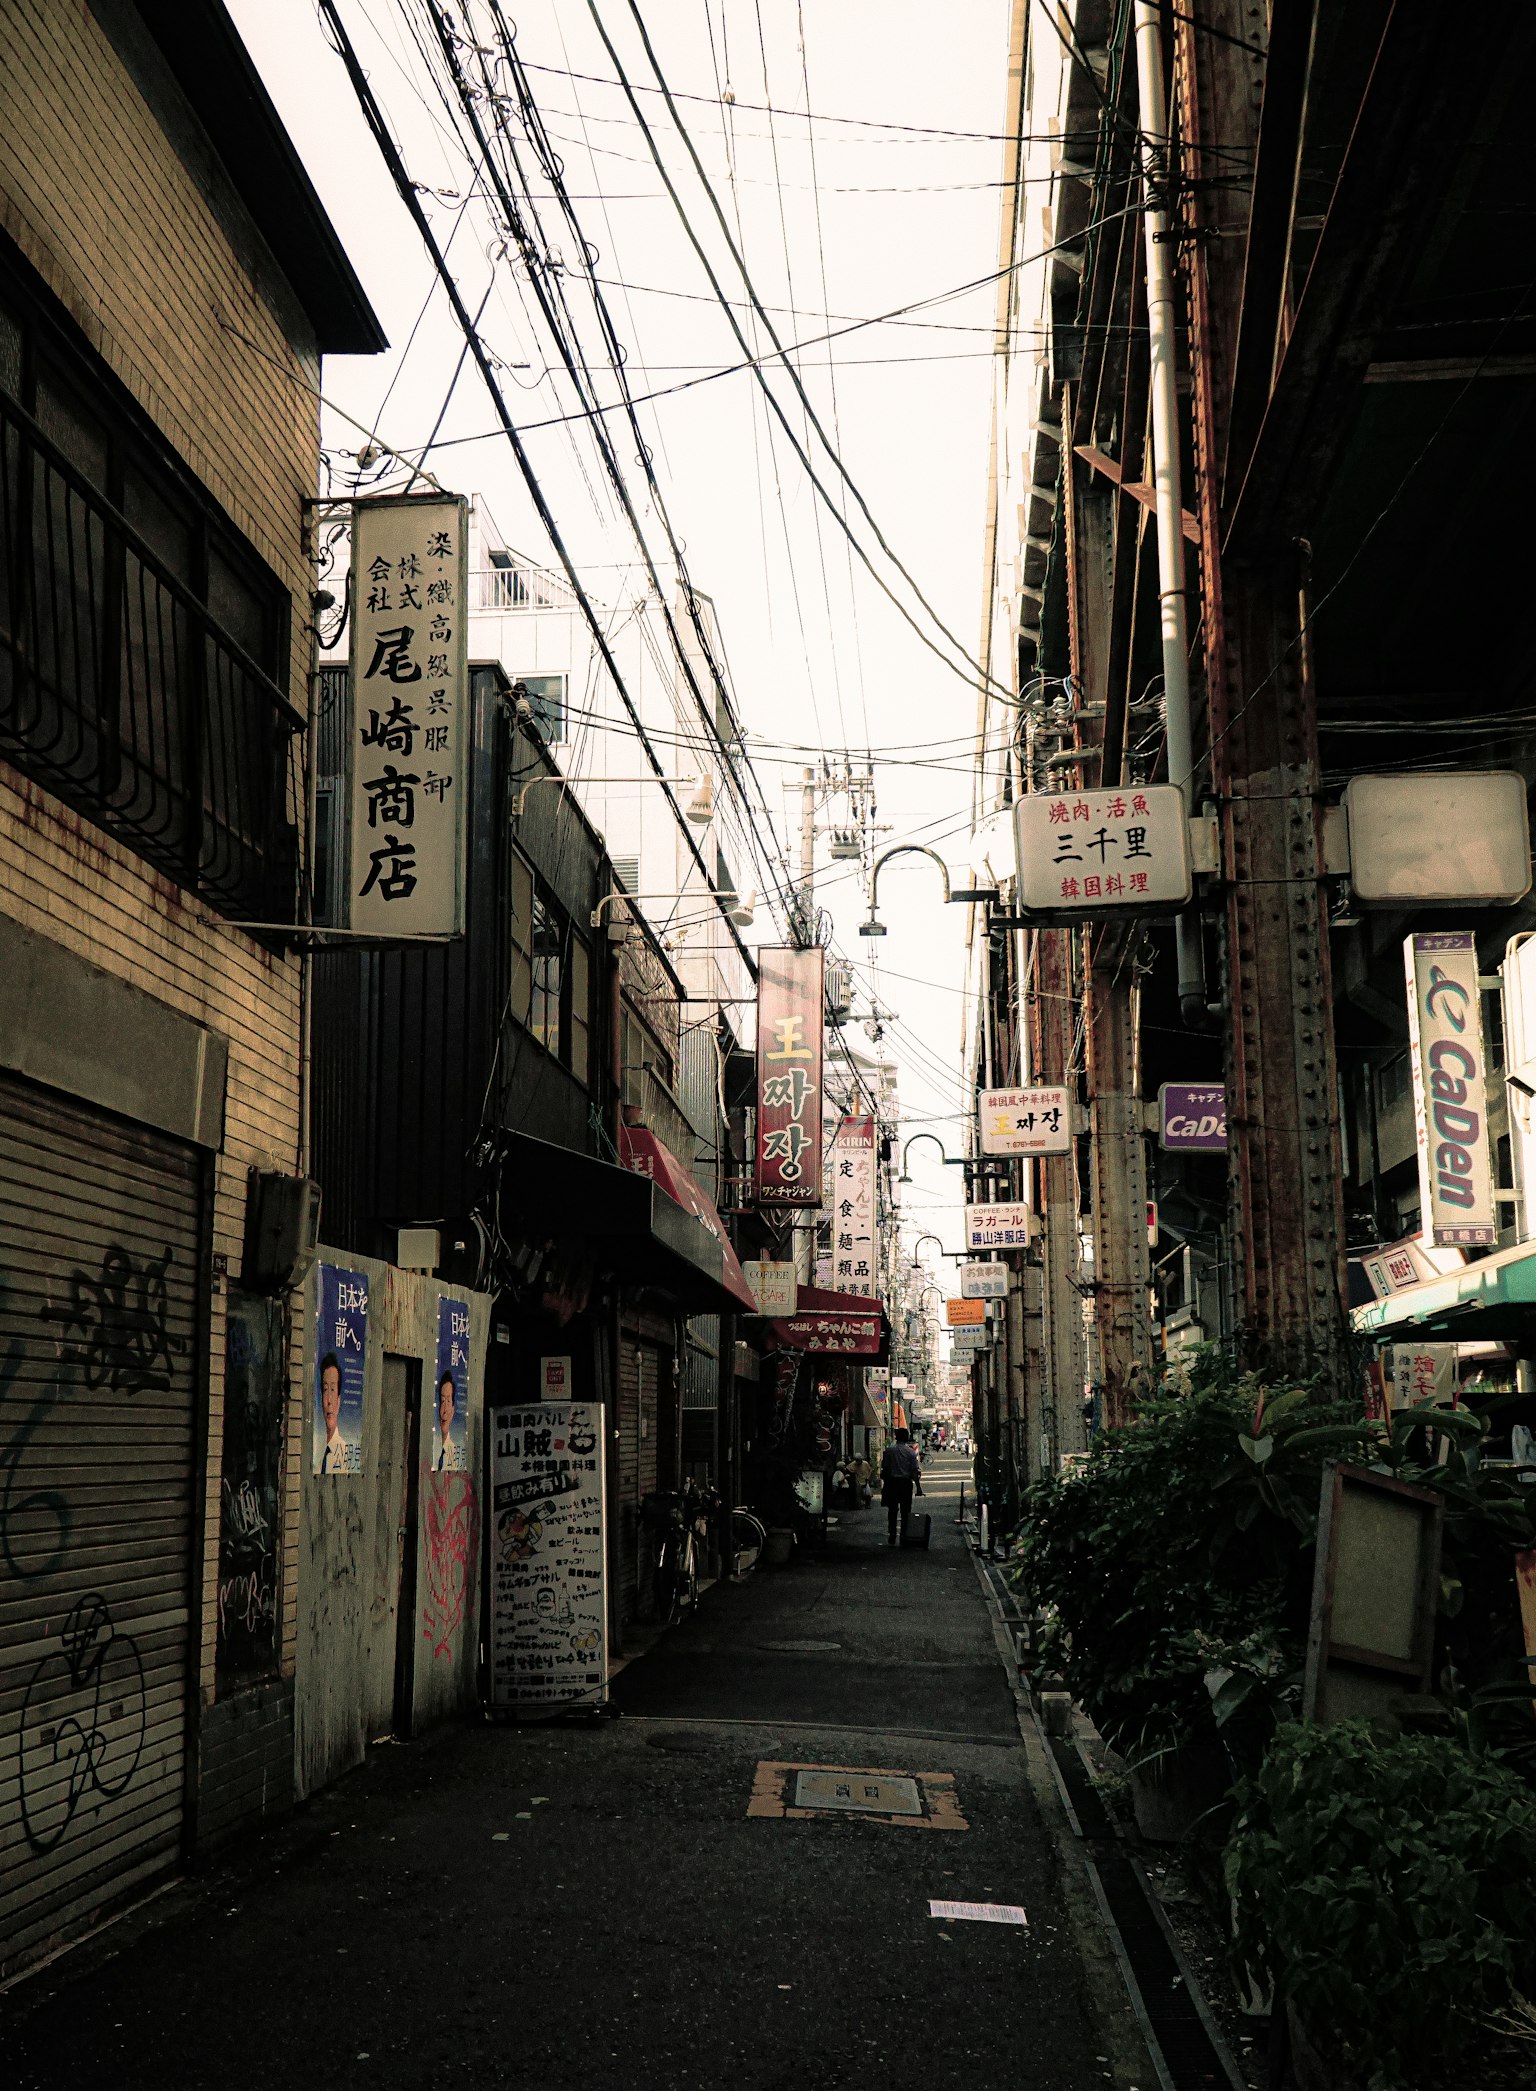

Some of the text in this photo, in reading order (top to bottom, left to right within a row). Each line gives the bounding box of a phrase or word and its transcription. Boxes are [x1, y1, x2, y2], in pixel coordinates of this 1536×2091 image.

[358, 625, 423, 902] 尾崎商店
[1052, 826, 1152, 864] 三千里
[1060, 872, 1150, 900] 韓国料理
[988, 1093, 1062, 1108] 韓国風中華料理
[1166, 1115, 1228, 1137] CaDe
[1430, 1040, 1479, 1209] CaDen
[838, 1137, 872, 1147] KIRIN
[973, 1215, 1022, 1227] ラガール
[972, 1230, 1025, 1245] 勝山洋服店
[750, 1271, 789, 1280] COFFEE
[337, 1282, 368, 1315] 日本を
[809, 1336, 856, 1350] みねや
[332, 1443, 361, 1471] 公明党
